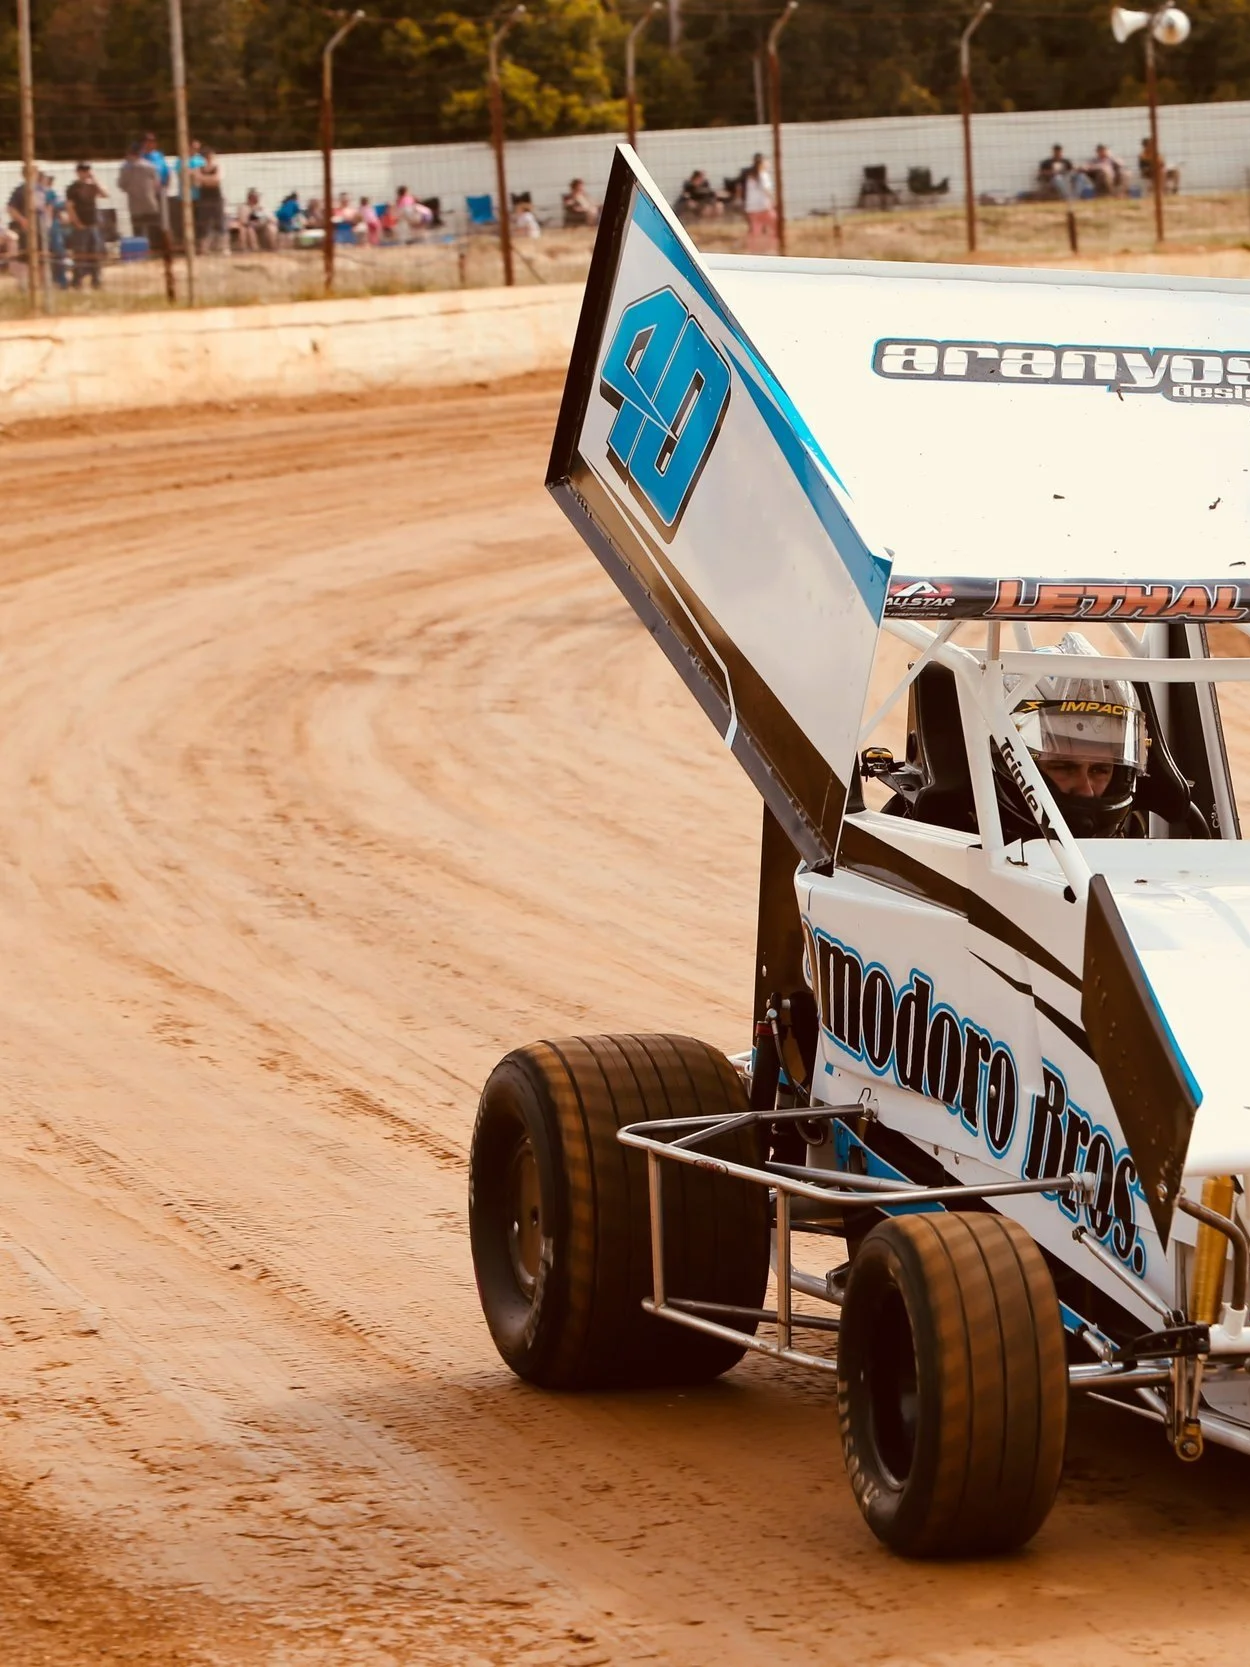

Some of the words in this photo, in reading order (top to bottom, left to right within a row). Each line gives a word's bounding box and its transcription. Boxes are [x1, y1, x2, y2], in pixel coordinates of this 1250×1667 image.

[599, 284, 732, 542] 40
[884, 597, 956, 607] ALLSTAR
[983, 579, 1249, 620] LETHAL
[1022, 1057, 1147, 1280] Bros.
